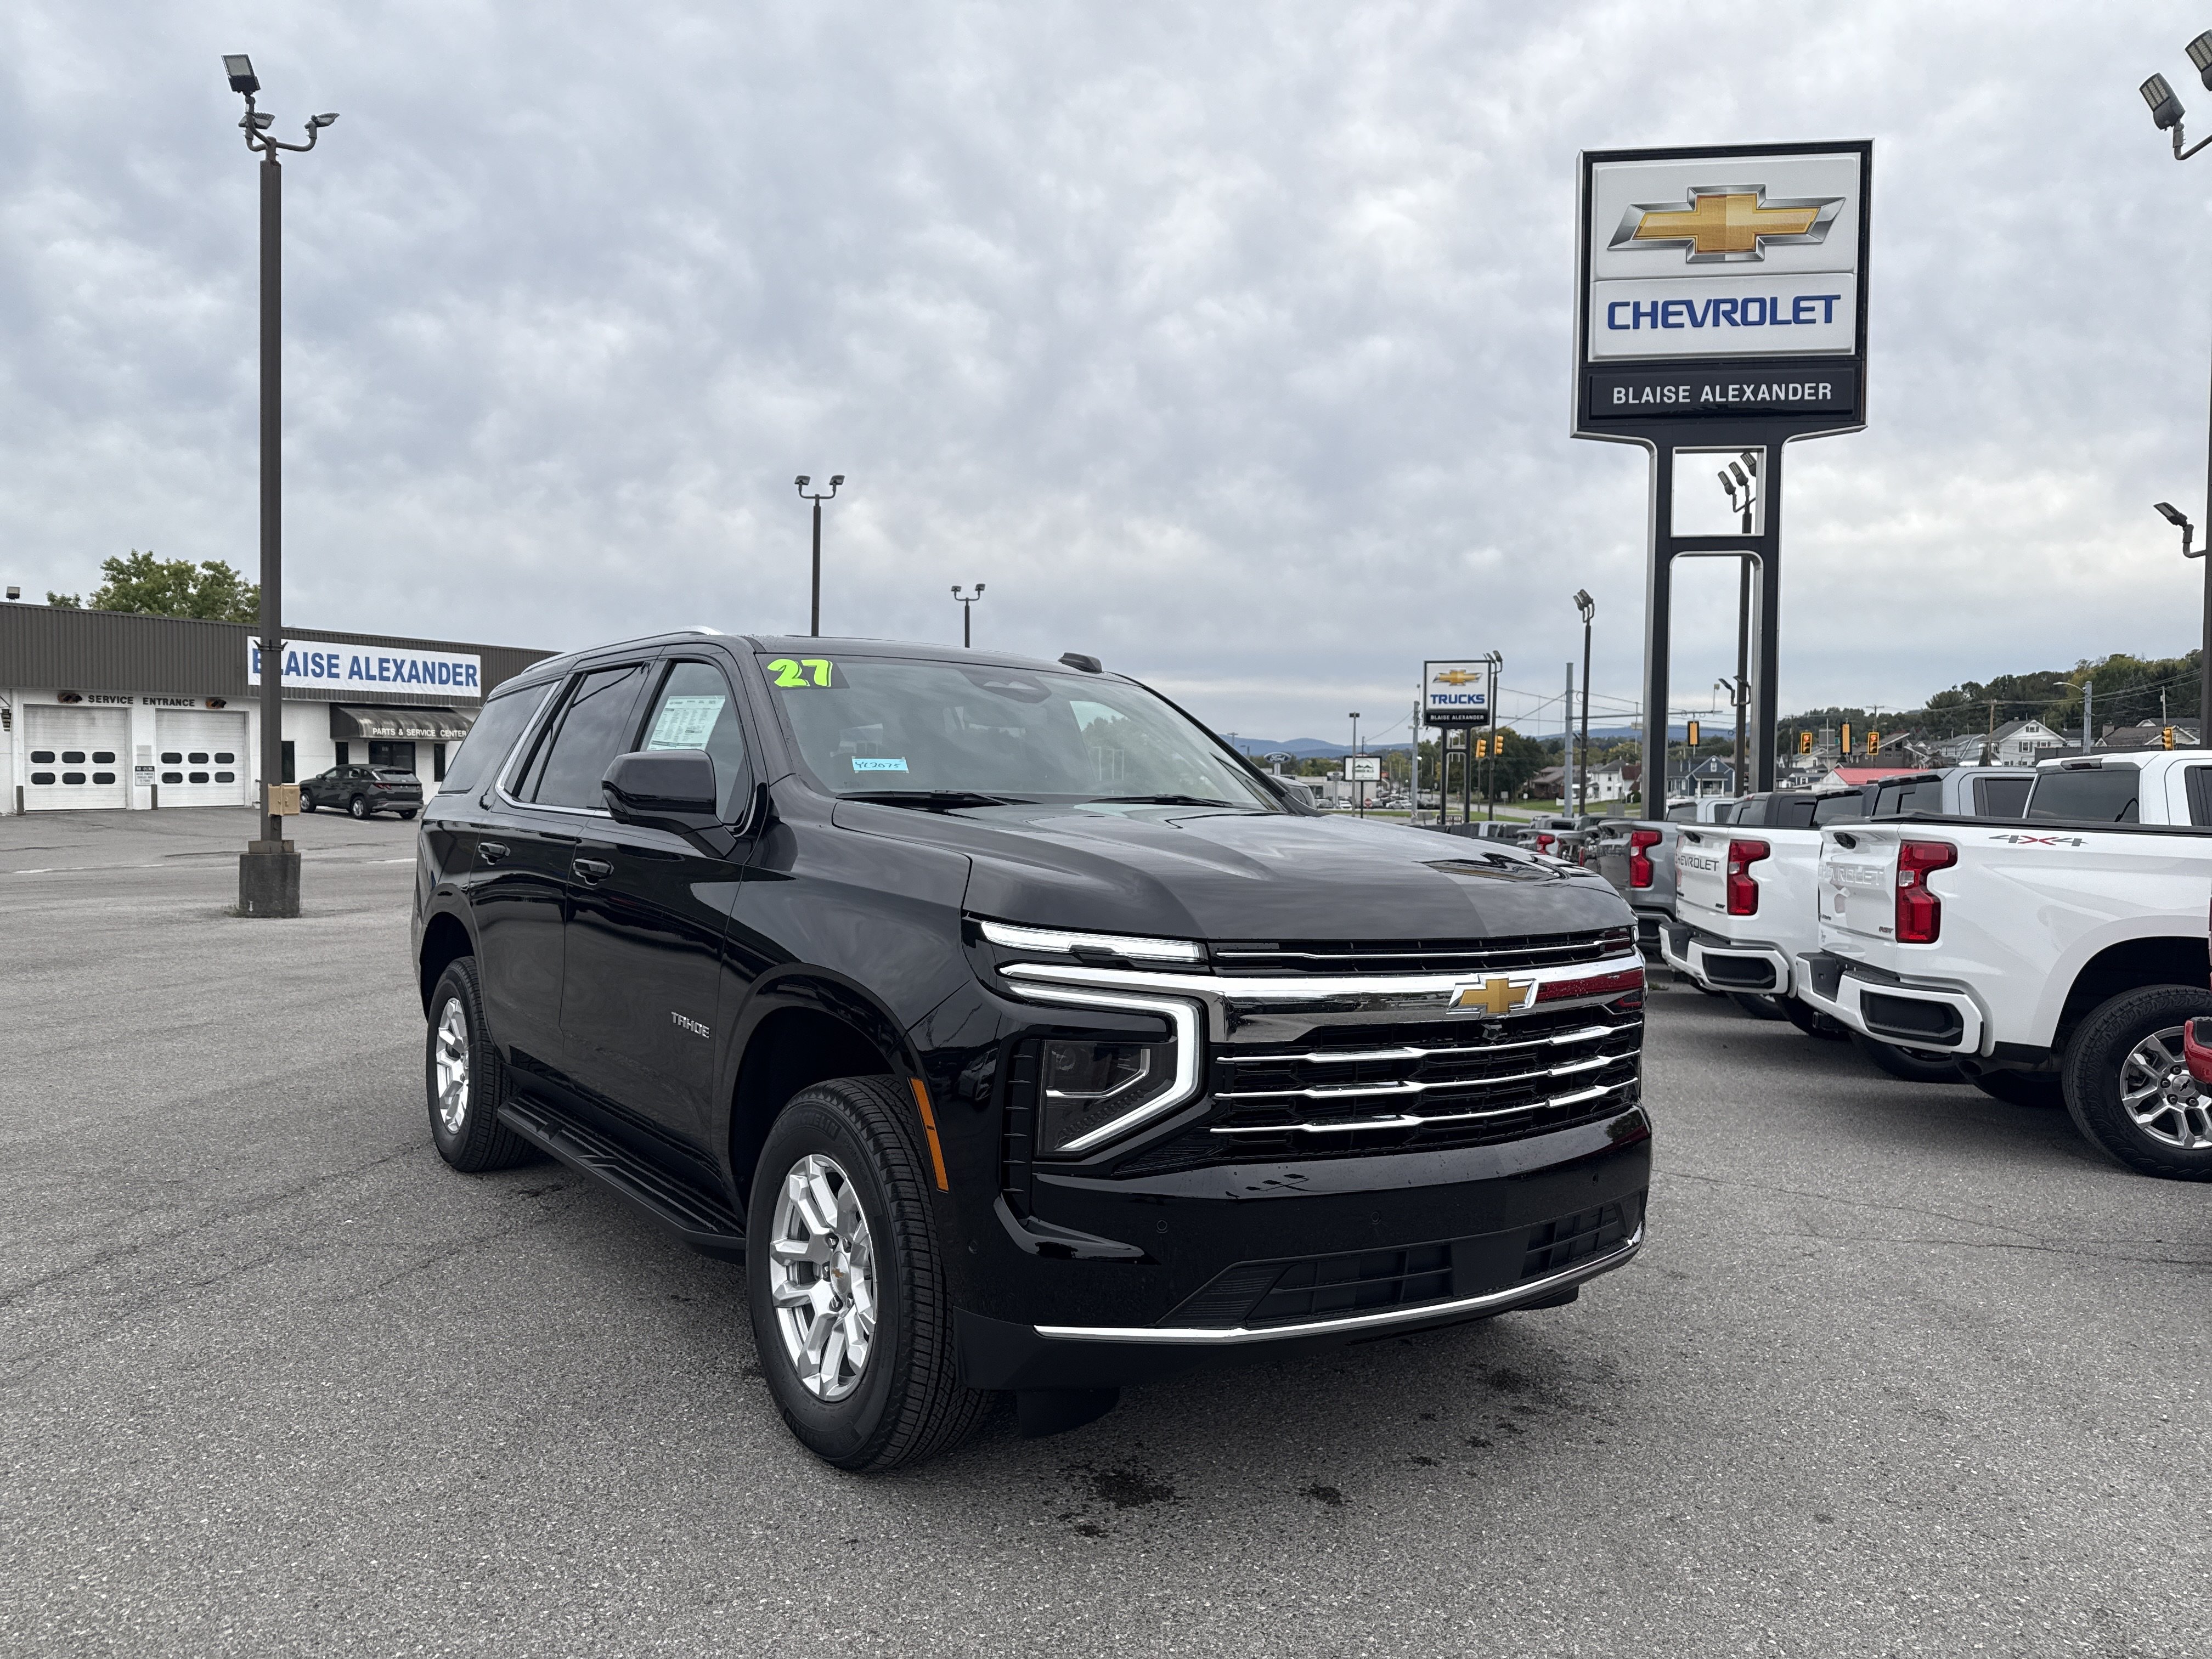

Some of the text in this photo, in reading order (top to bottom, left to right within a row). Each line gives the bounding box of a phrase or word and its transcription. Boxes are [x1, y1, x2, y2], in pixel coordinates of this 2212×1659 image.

[1607, 294, 1841, 330] CHEVROLET
[1613, 382, 1832, 404] BLAISE ALEXANDER
[252, 647, 478, 687] BAISE ALEXANDER
[767, 658, 833, 687] 27
[88, 695, 195, 707] SERVICE ENTRANCE
[1430, 693, 1485, 704] TRUCKS
[373, 727, 396, 736] PARTS
[406, 729, 436, 737] SERVICE
[440, 729, 467, 738] CENTER
[671, 1011, 710, 1039] TAHOE
